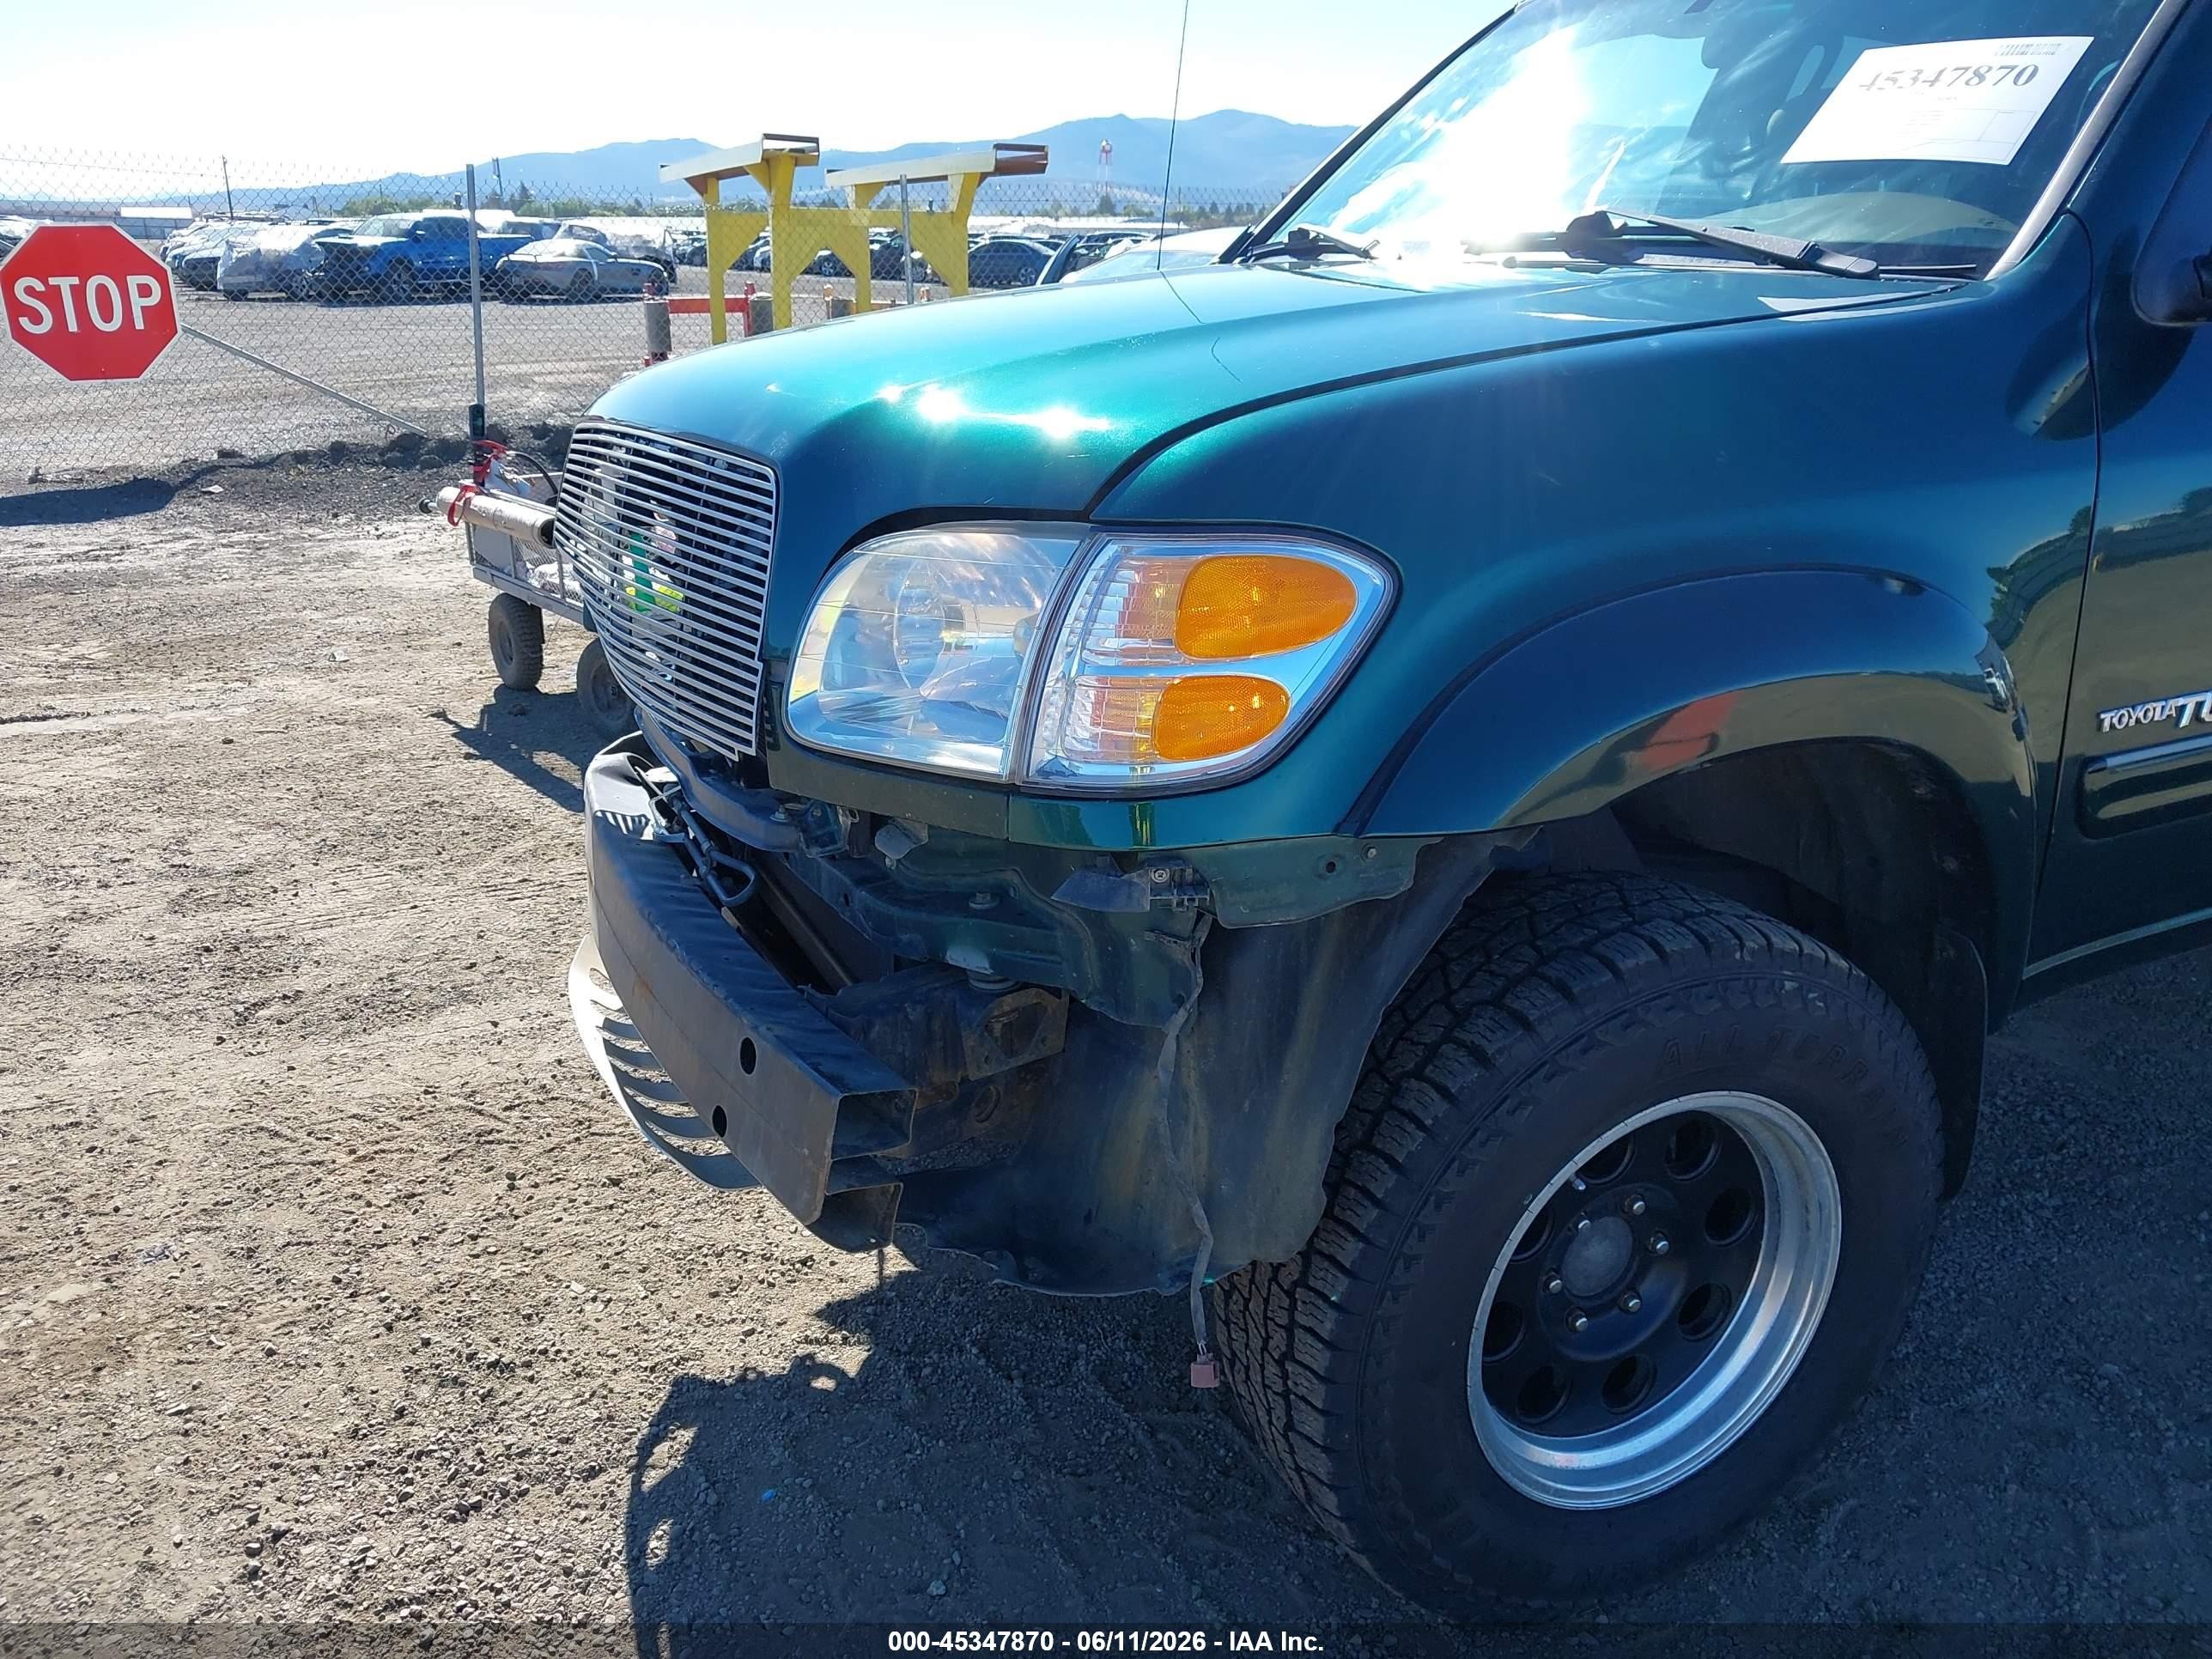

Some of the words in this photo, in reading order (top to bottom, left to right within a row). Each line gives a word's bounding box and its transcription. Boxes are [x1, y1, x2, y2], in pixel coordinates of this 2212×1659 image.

[1859, 63, 2040, 92] 45347870
[14, 274, 161, 334] STOP
[2100, 698, 2177, 732] TOYOTA
